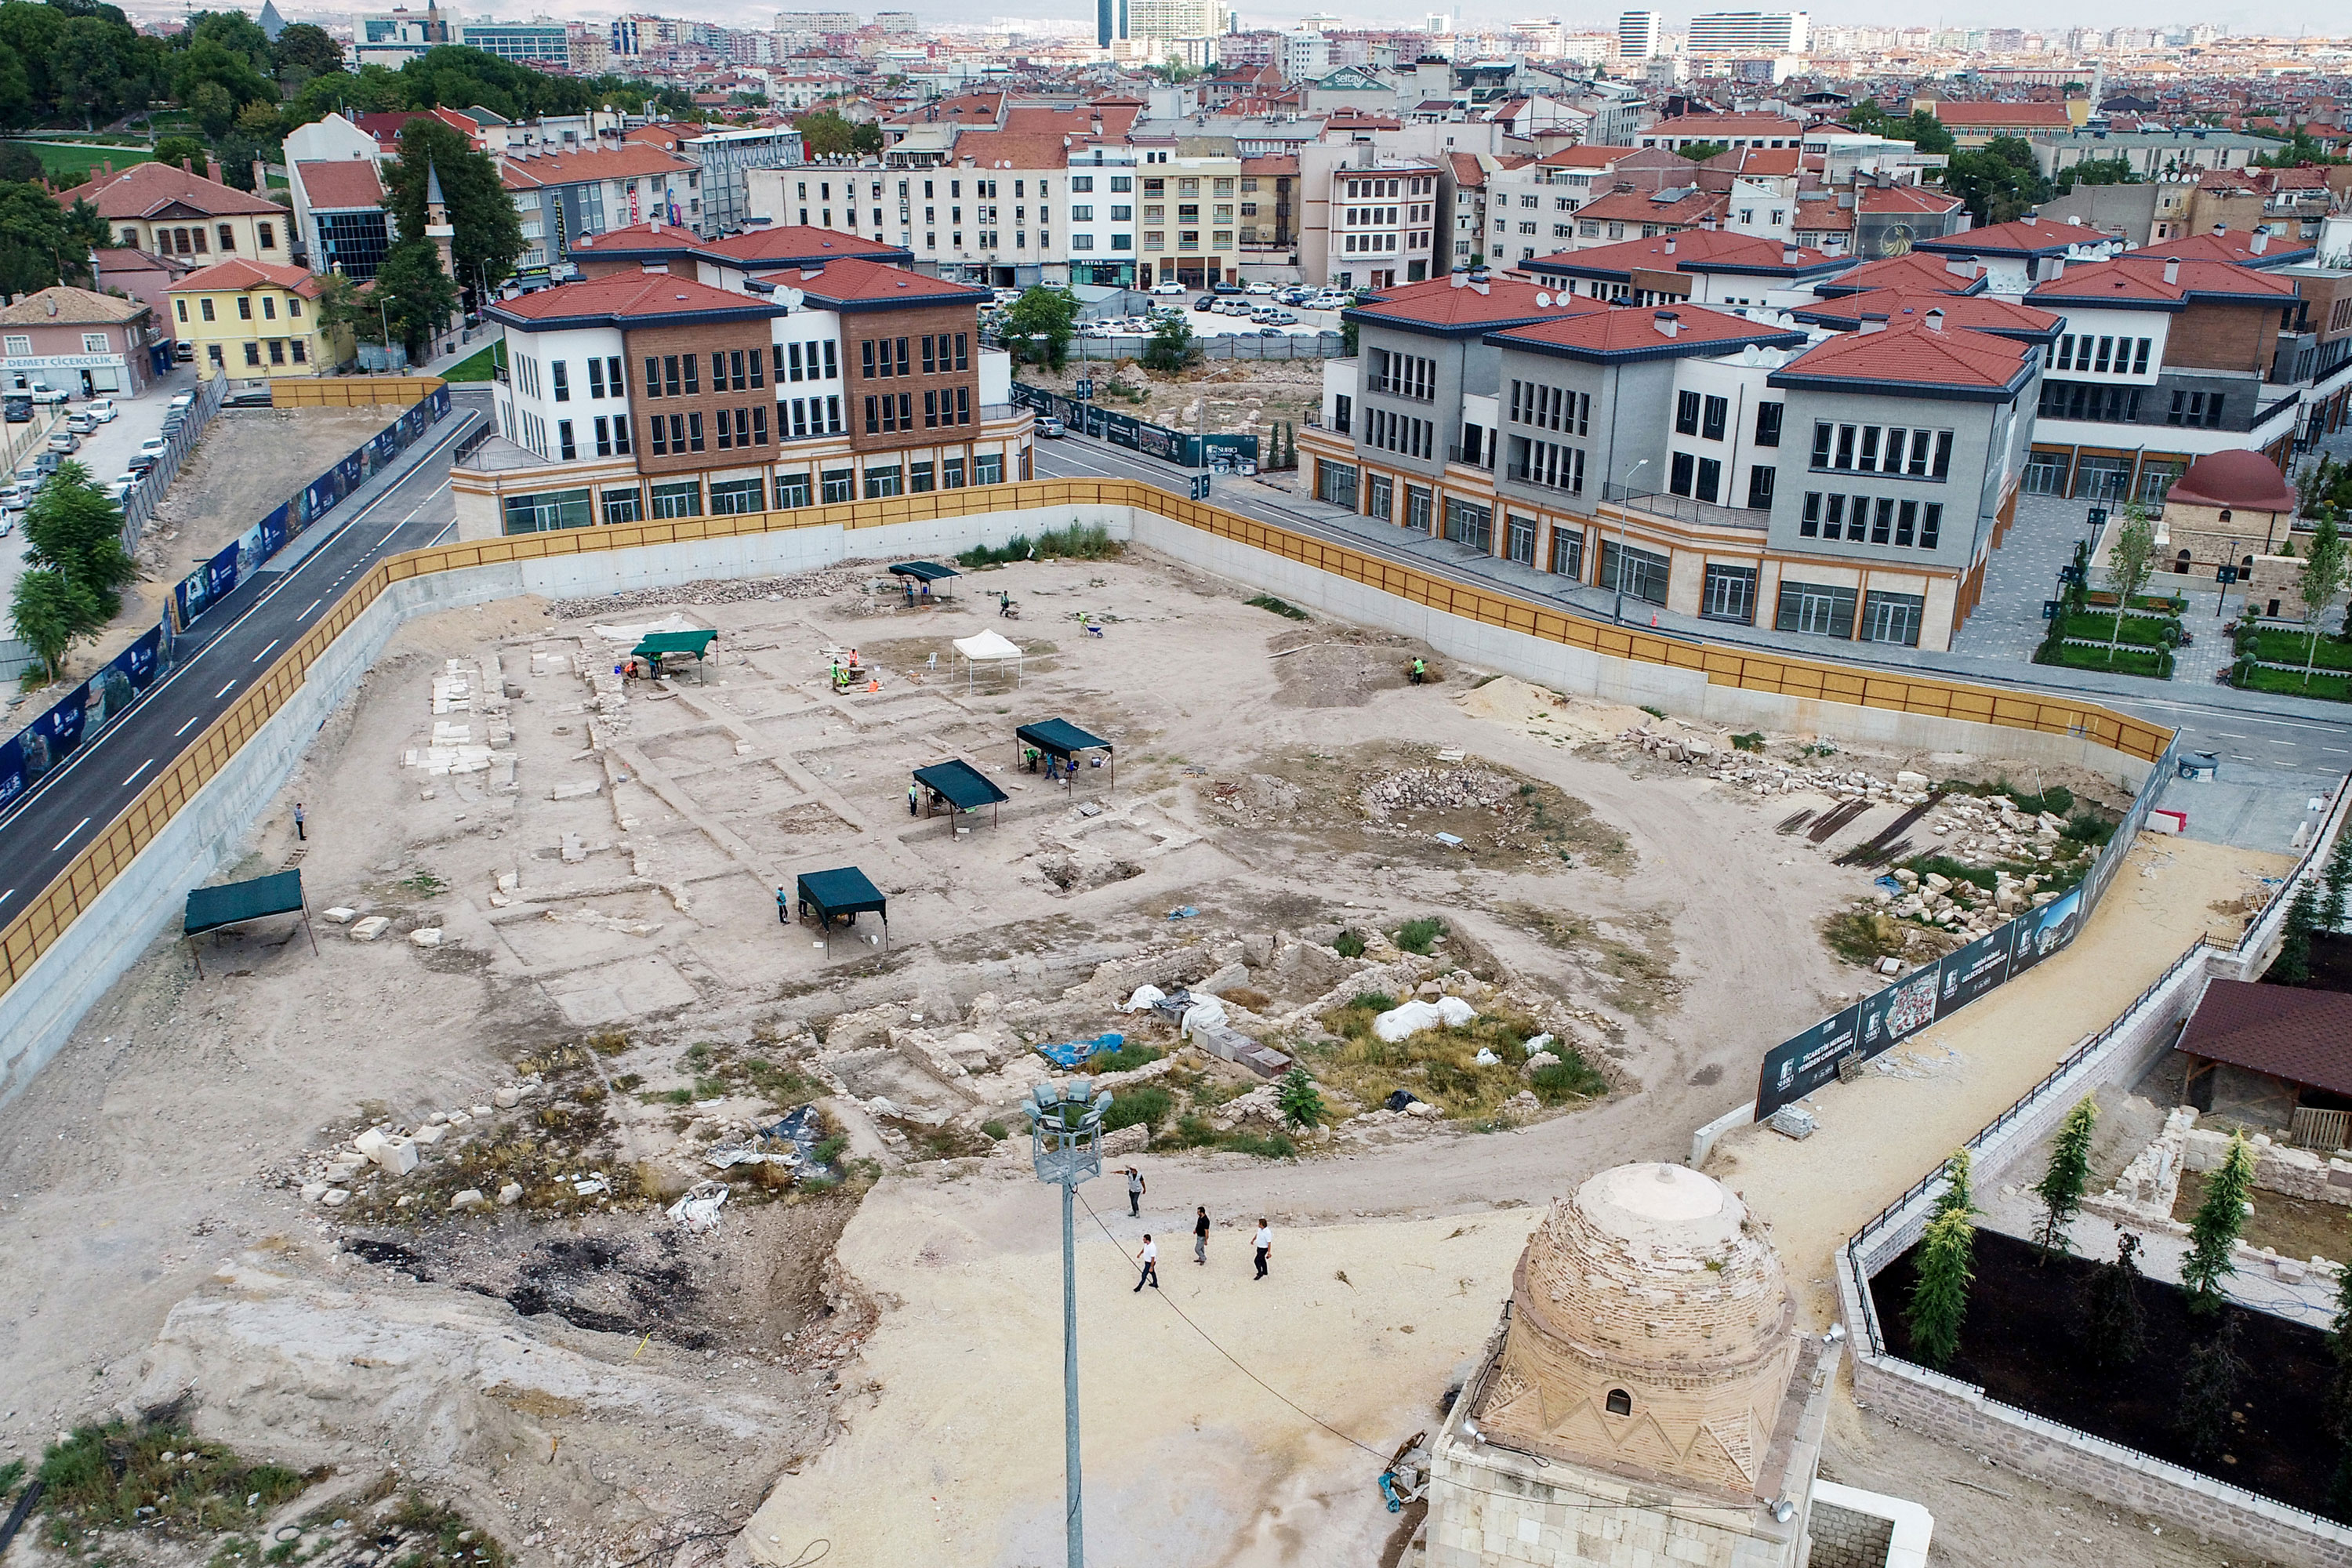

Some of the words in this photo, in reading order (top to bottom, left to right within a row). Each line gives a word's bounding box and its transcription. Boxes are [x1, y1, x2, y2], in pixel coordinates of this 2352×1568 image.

[1334, 73, 1363, 83] Seltav
[8, 358, 46, 367] DEMET
[50, 355, 112, 368] ÇİÇEKÇİLİK
[1798, 1055, 1821, 1073] YENİDEN
[1820, 1037, 1853, 1061] CANLANIYOR
[1802, 1043, 1829, 1063] TİCARETİN
[1829, 1029, 1852, 1048] MERKEZİ
